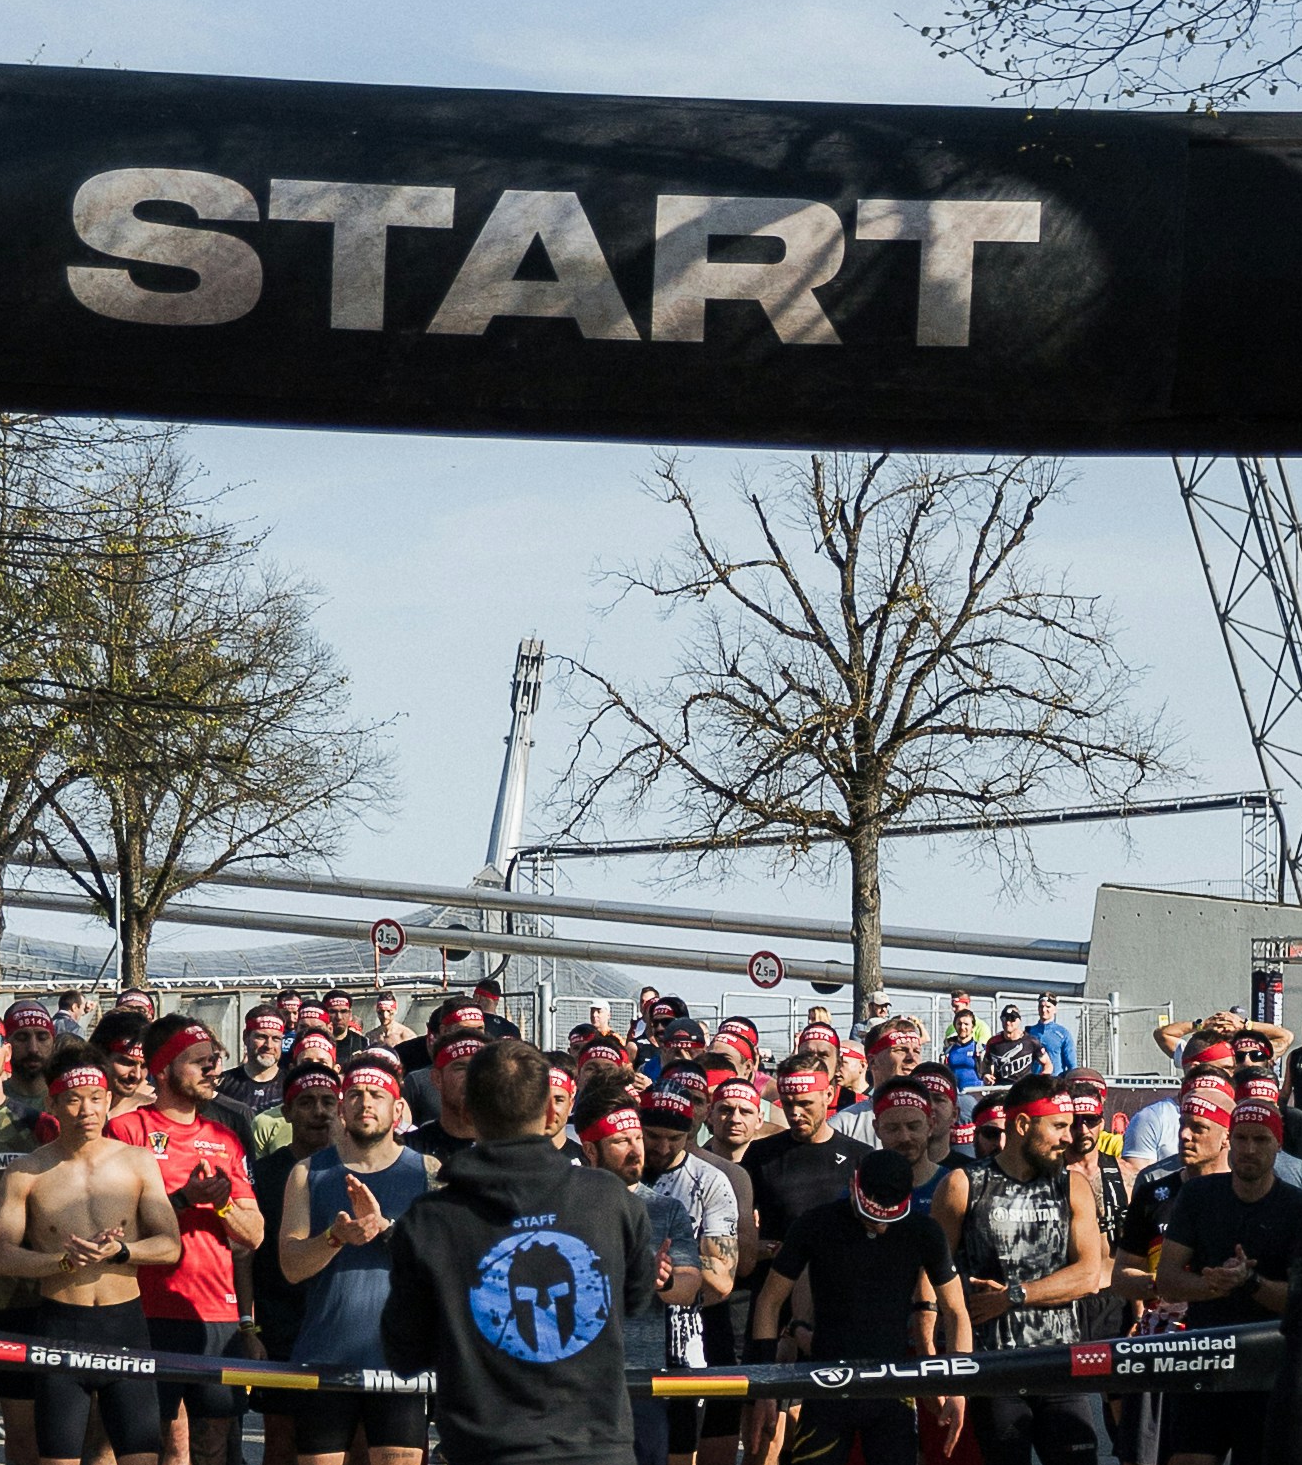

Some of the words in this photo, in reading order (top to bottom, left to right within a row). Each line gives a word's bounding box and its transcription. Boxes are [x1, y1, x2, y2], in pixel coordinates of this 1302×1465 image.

[67, 168, 1041, 348] START
[513, 1214, 557, 1228] STAFF
[1009, 1208, 1060, 1222] SPARTAN
[1115, 1335, 1236, 1354] Comunidad
[30, 1351, 61, 1365] de
[69, 1353, 156, 1374] Madrid
[859, 1358, 980, 1379] JLAB
[1116, 1359, 1146, 1374] de
[1153, 1354, 1235, 1373] Madrid
